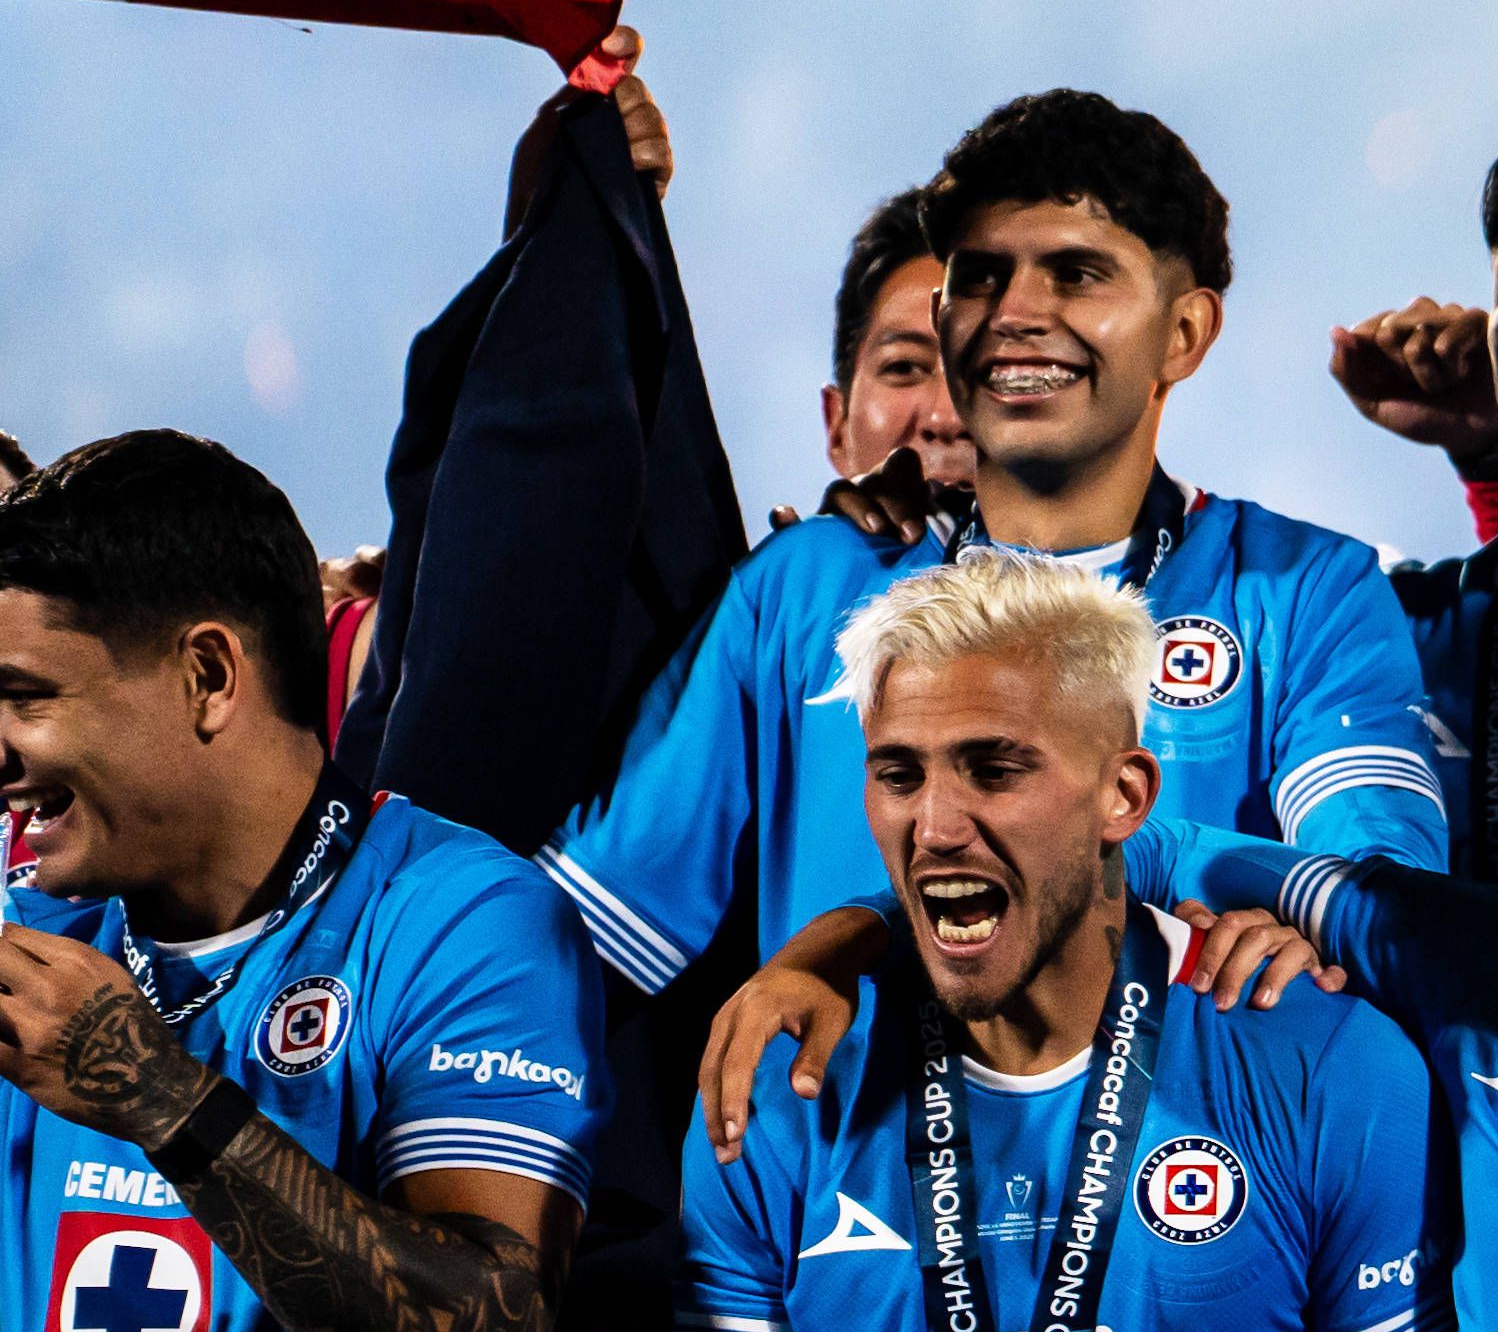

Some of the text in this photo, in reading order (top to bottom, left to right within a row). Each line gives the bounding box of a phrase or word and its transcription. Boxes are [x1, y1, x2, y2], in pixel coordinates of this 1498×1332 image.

[1175, 619, 1237, 658] DE FUTBOL
[1188, 690, 1222, 707] AZUL
[263, 978, 348, 1023] CLUB DE FUTBOL
[921, 999, 947, 1074] 2025
[1096, 981, 1150, 1127] Concacaf
[268, 1049, 333, 1073] CRUZ AZUL
[922, 1076, 955, 1142] CUP
[1141, 1140, 1243, 1181] CLUB DE FUTBOL
[1053, 1132, 1117, 1325] CHAMPIONS
[1152, 1219, 1229, 1241] CRUZ AZUL
